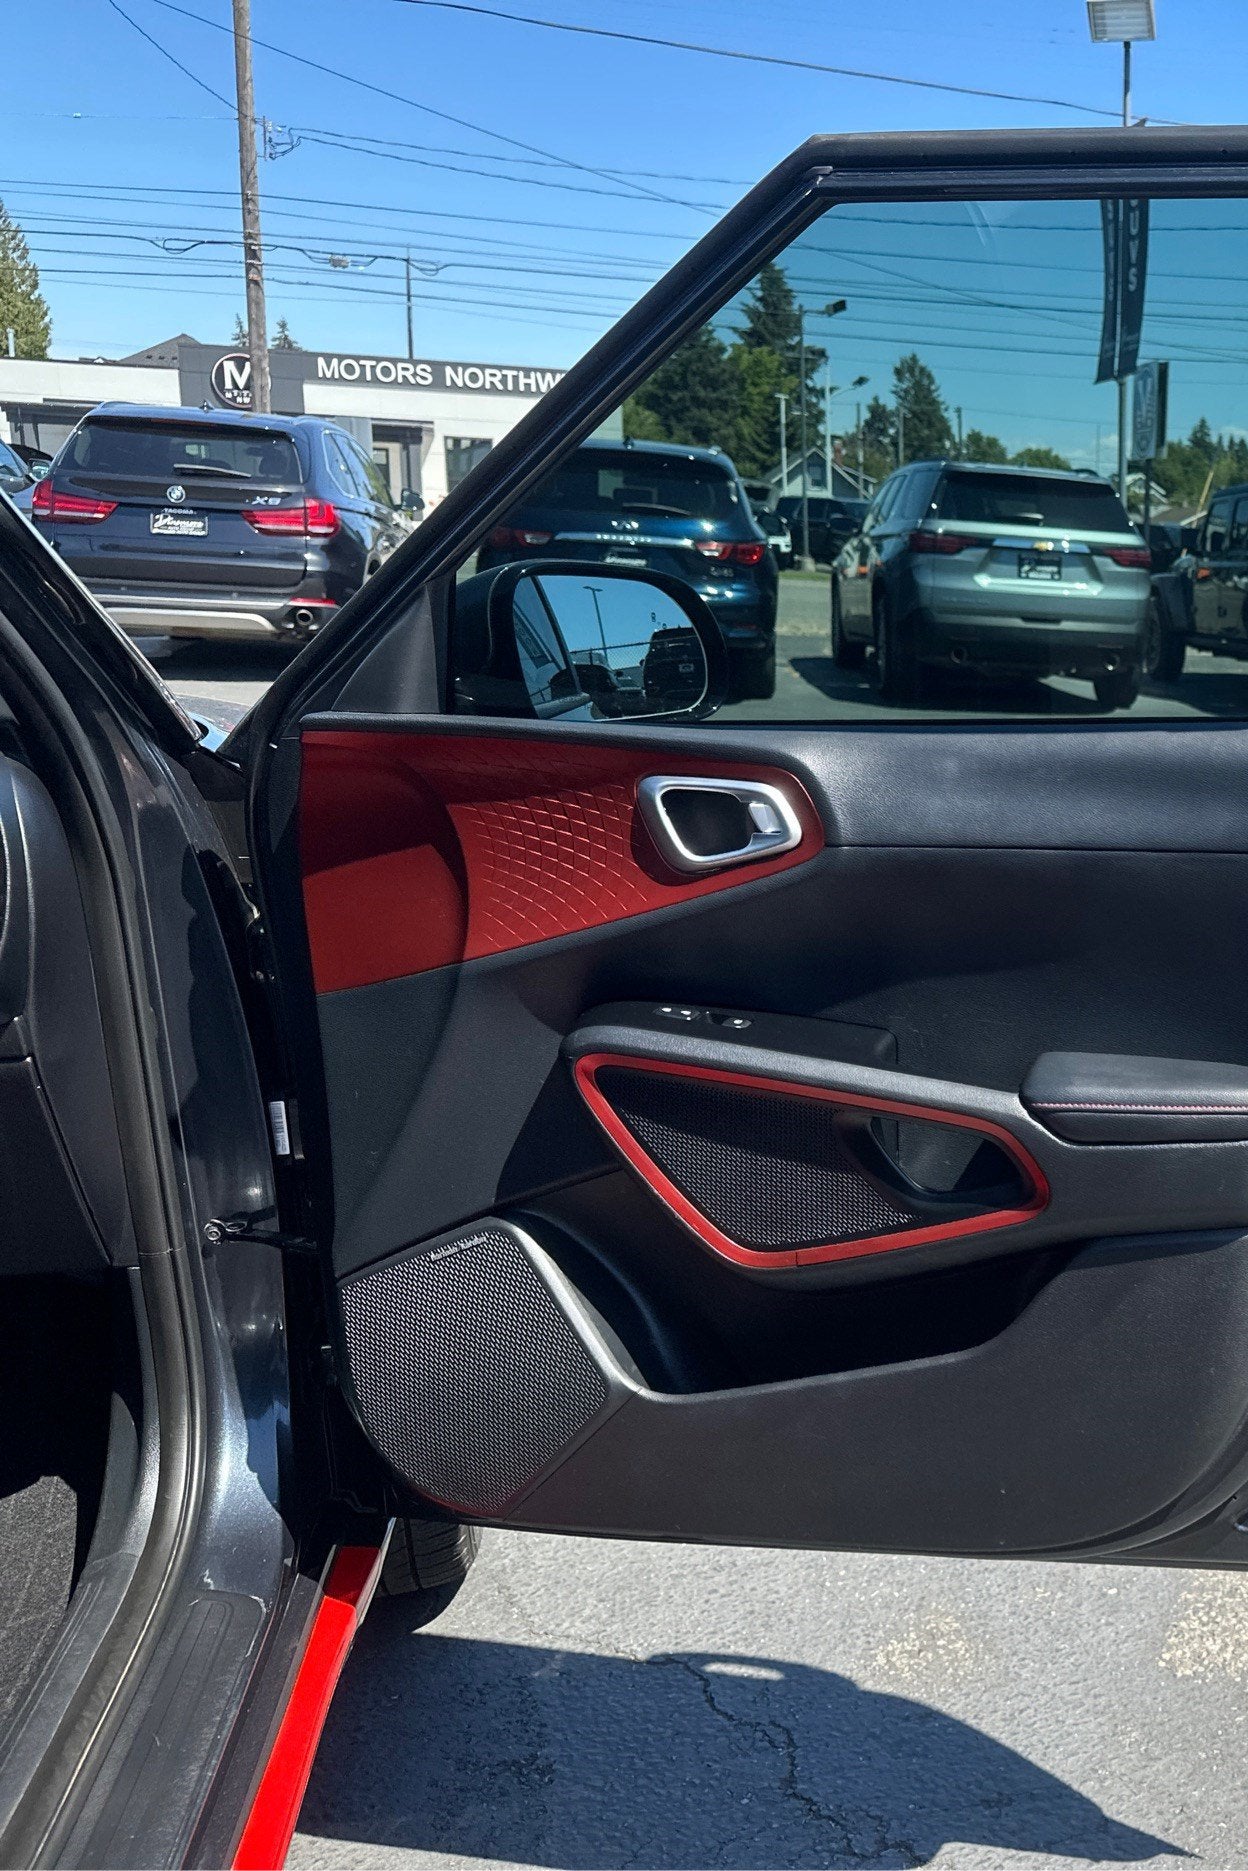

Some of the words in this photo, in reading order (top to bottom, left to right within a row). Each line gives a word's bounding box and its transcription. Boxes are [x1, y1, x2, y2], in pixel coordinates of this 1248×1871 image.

[222, 360, 251, 390] M
[317, 357, 433, 386] MOTORS
[445, 365, 566, 393] NORTHW
